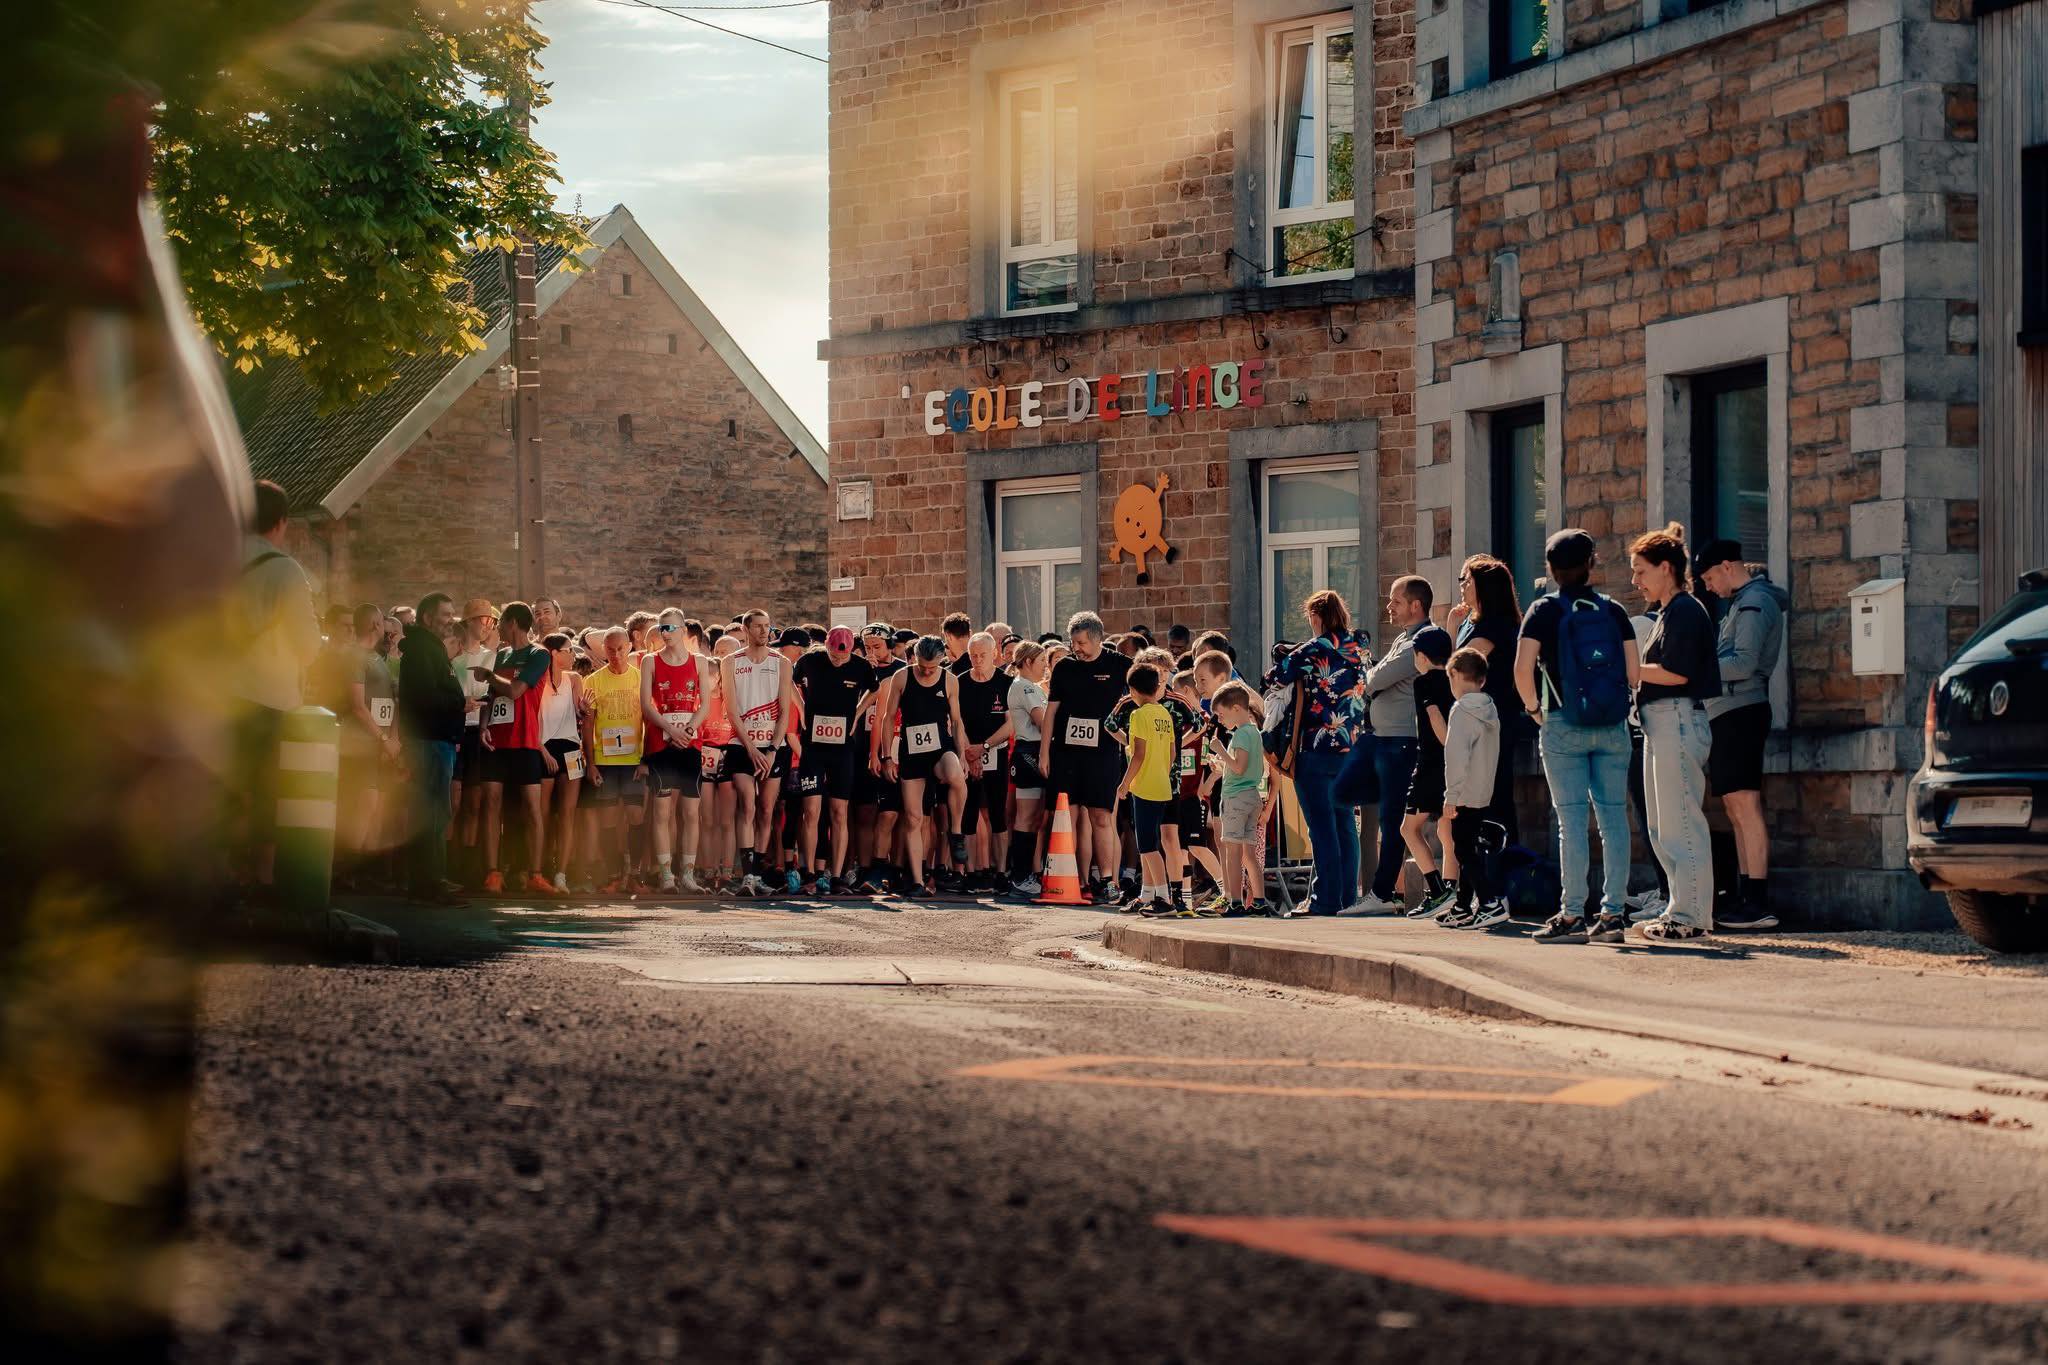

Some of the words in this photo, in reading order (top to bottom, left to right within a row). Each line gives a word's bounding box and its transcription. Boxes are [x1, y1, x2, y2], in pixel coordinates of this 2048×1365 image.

[925, 380, 1043, 435] ECOLE
[1067, 373, 1121, 423] DE
[380, 705, 391, 719] 87
[493, 704, 507, 717] 96
[747, 730, 774, 741] 566
[815, 725, 843, 738] 800
[1070, 725, 1095, 739] 250
[616, 735, 622, 748] 1
[915, 731, 932, 746] 84
